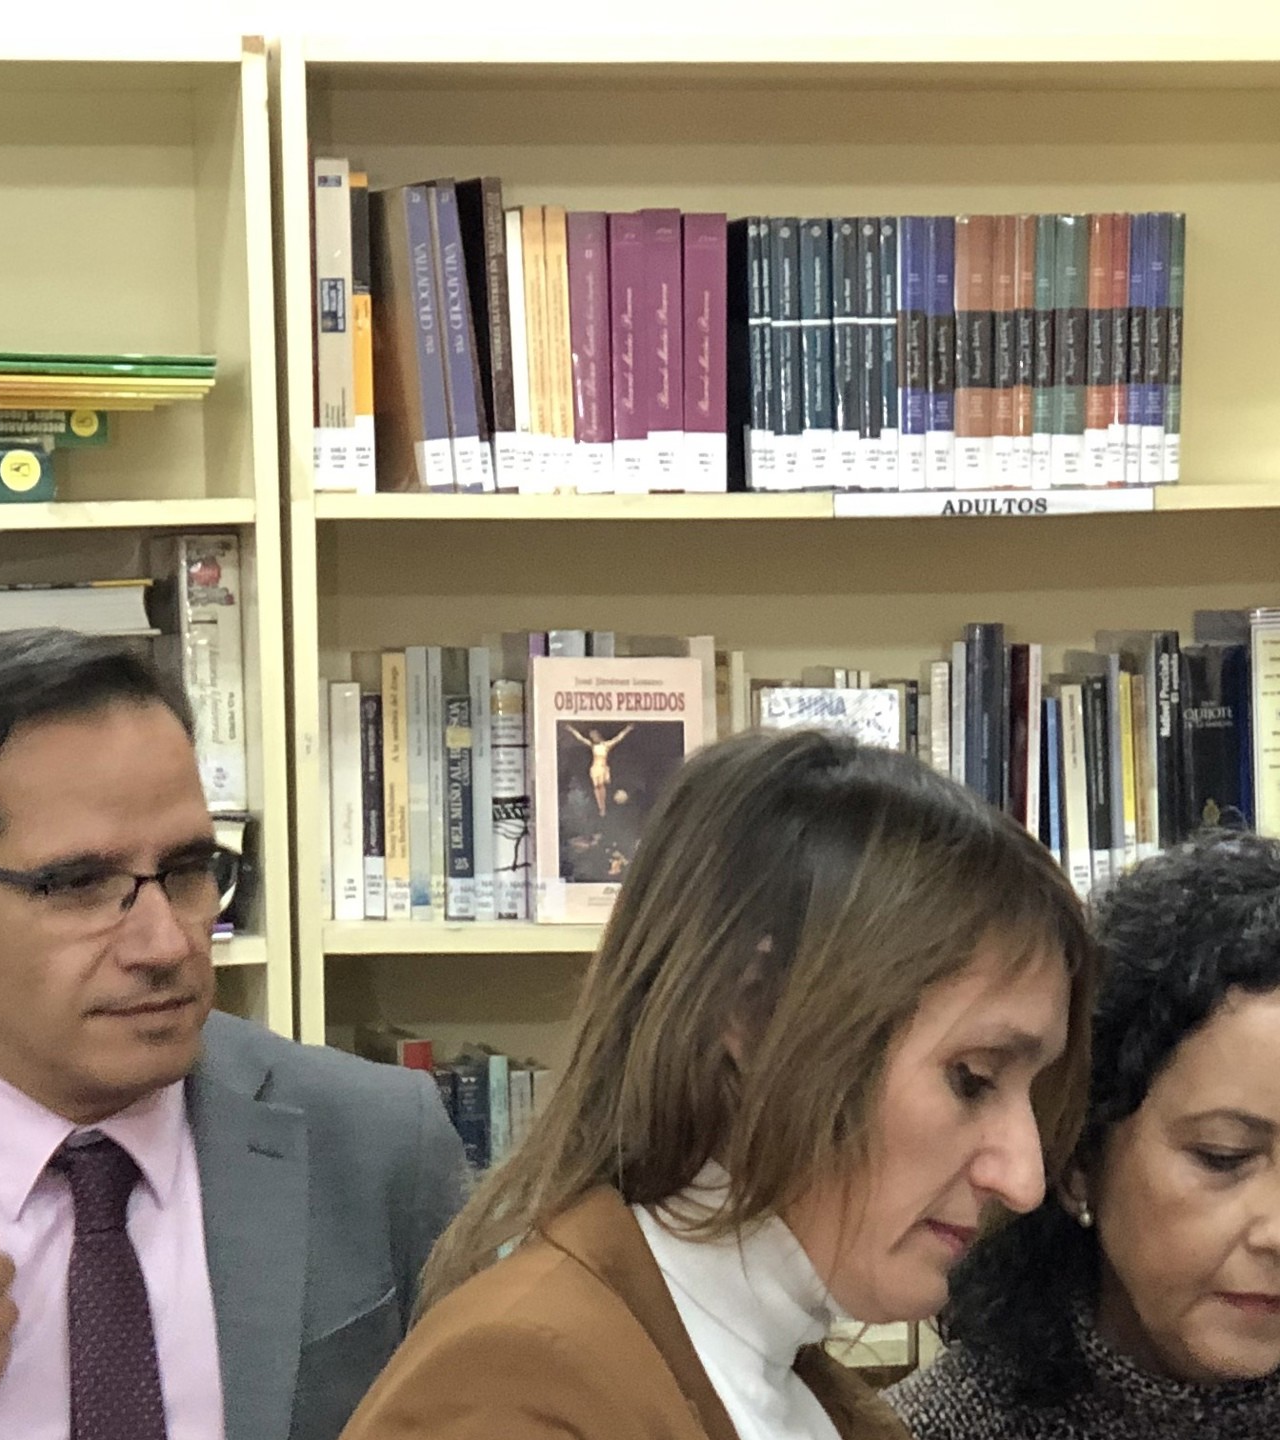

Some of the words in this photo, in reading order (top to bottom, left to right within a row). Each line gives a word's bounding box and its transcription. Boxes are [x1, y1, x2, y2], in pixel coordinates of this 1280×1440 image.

[943, 495, 1048, 517] ADULTOS
[554, 691, 613, 714] OBJETOS
[616, 691, 686, 713] PERDIDOS
[449, 761, 462, 780] AL
[447, 782, 463, 819] MIÑO
[450, 822, 463, 849] DEL
